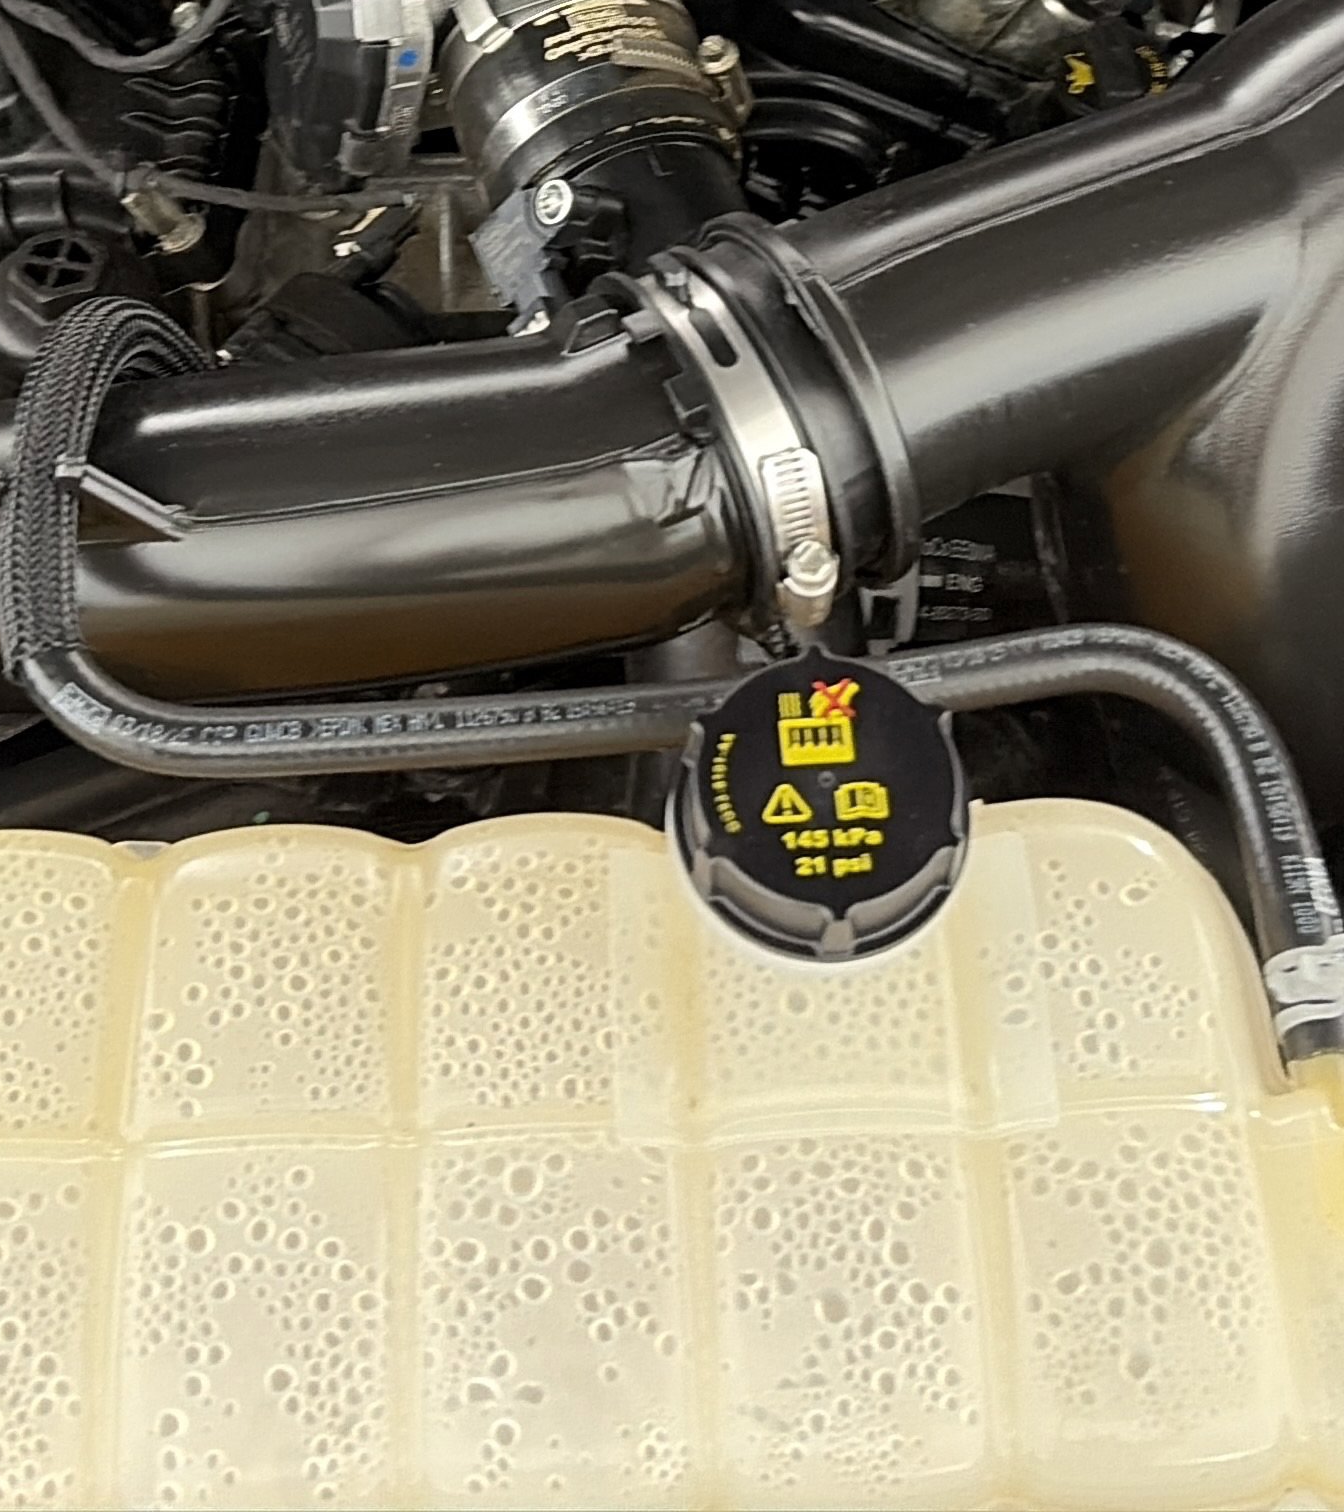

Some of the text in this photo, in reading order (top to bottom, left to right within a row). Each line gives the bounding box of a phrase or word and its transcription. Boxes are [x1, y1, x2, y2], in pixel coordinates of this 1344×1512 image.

[781, 827, 883, 849] 145 kPa
[795, 852, 873, 877] 21 psi
